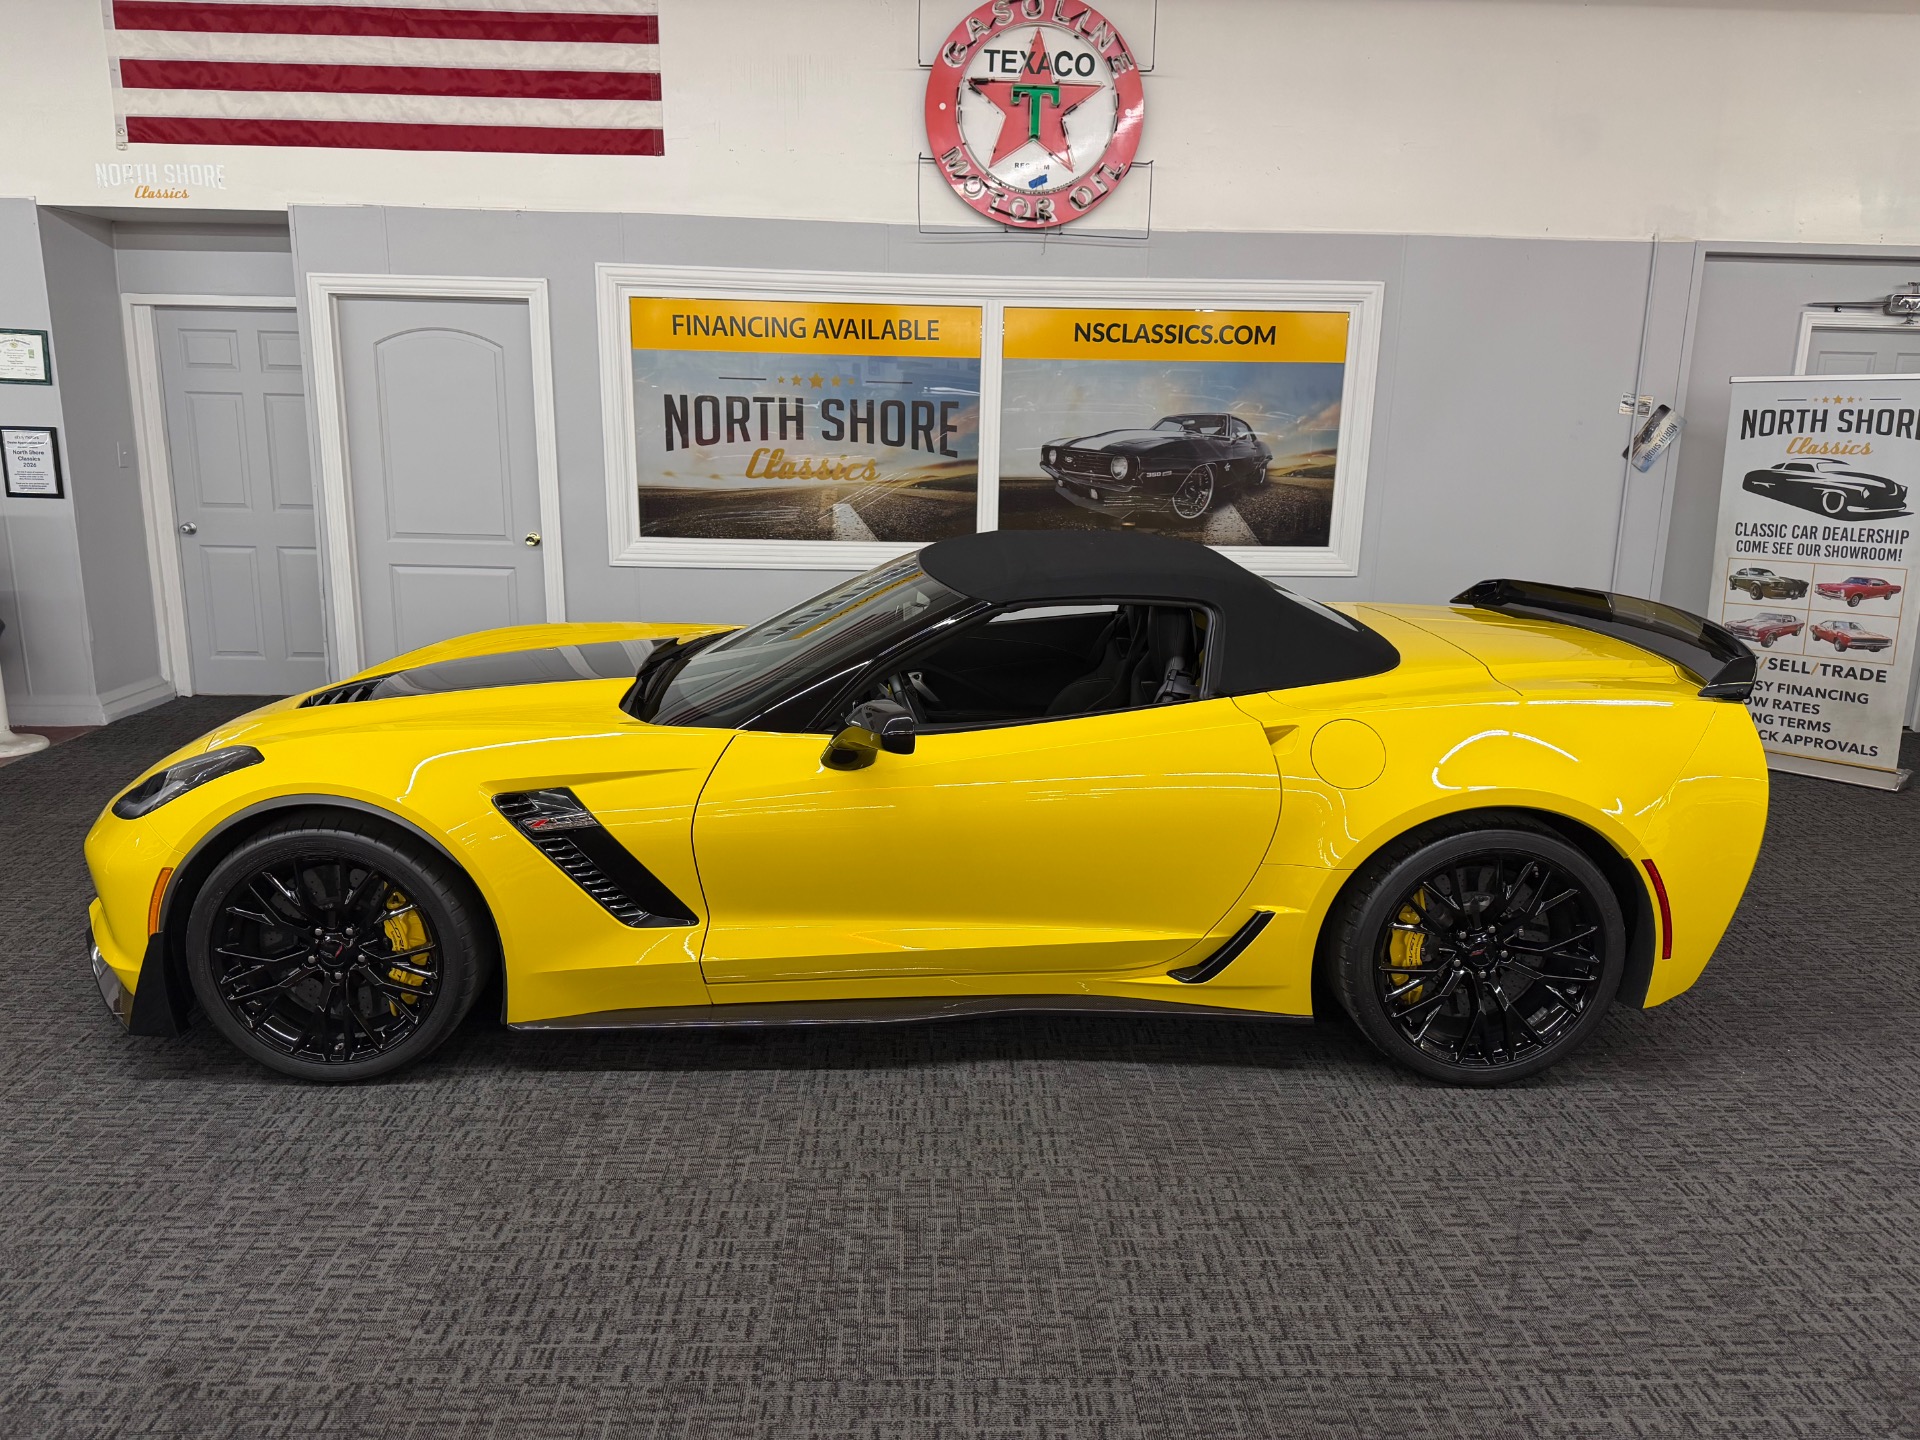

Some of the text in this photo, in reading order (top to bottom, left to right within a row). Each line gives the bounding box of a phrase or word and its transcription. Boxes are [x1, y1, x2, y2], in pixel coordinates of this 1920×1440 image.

[942, 0, 1135, 79] GASOLINE
[984, 49, 1095, 77] TEXACO
[1010, 83, 1061, 139] T
[95, 163, 227, 190] NORTH SHORE
[940, 146, 1126, 225] MOTOR OIL
[134, 185, 190, 199] Classics
[672, 314, 940, 341] FINANCING AVAILABLE
[1074, 322, 1276, 345] NSCLASSICS.COM
[663, 394, 959, 459] NORTH SHORE
[1659, 422, 1678, 445] NORTH
[1740, 409, 1828, 440] NORTH
[1641, 442, 1662, 462] SHORE
[1786, 437, 1873, 455] Classics
[745, 448, 881, 482] Classics
[1735, 522, 1910, 545] CLASSIC CAR DEALERSHIP
[1736, 539, 1903, 562] COME SEE OUR SHOWROOM!
[1742, 696, 1820, 715] OW RATES
[1753, 680, 1869, 705] SY FINANCING
[1751, 712, 1831, 733] NG TERMS
[1758, 729, 1878, 757] CK APPROVALS
